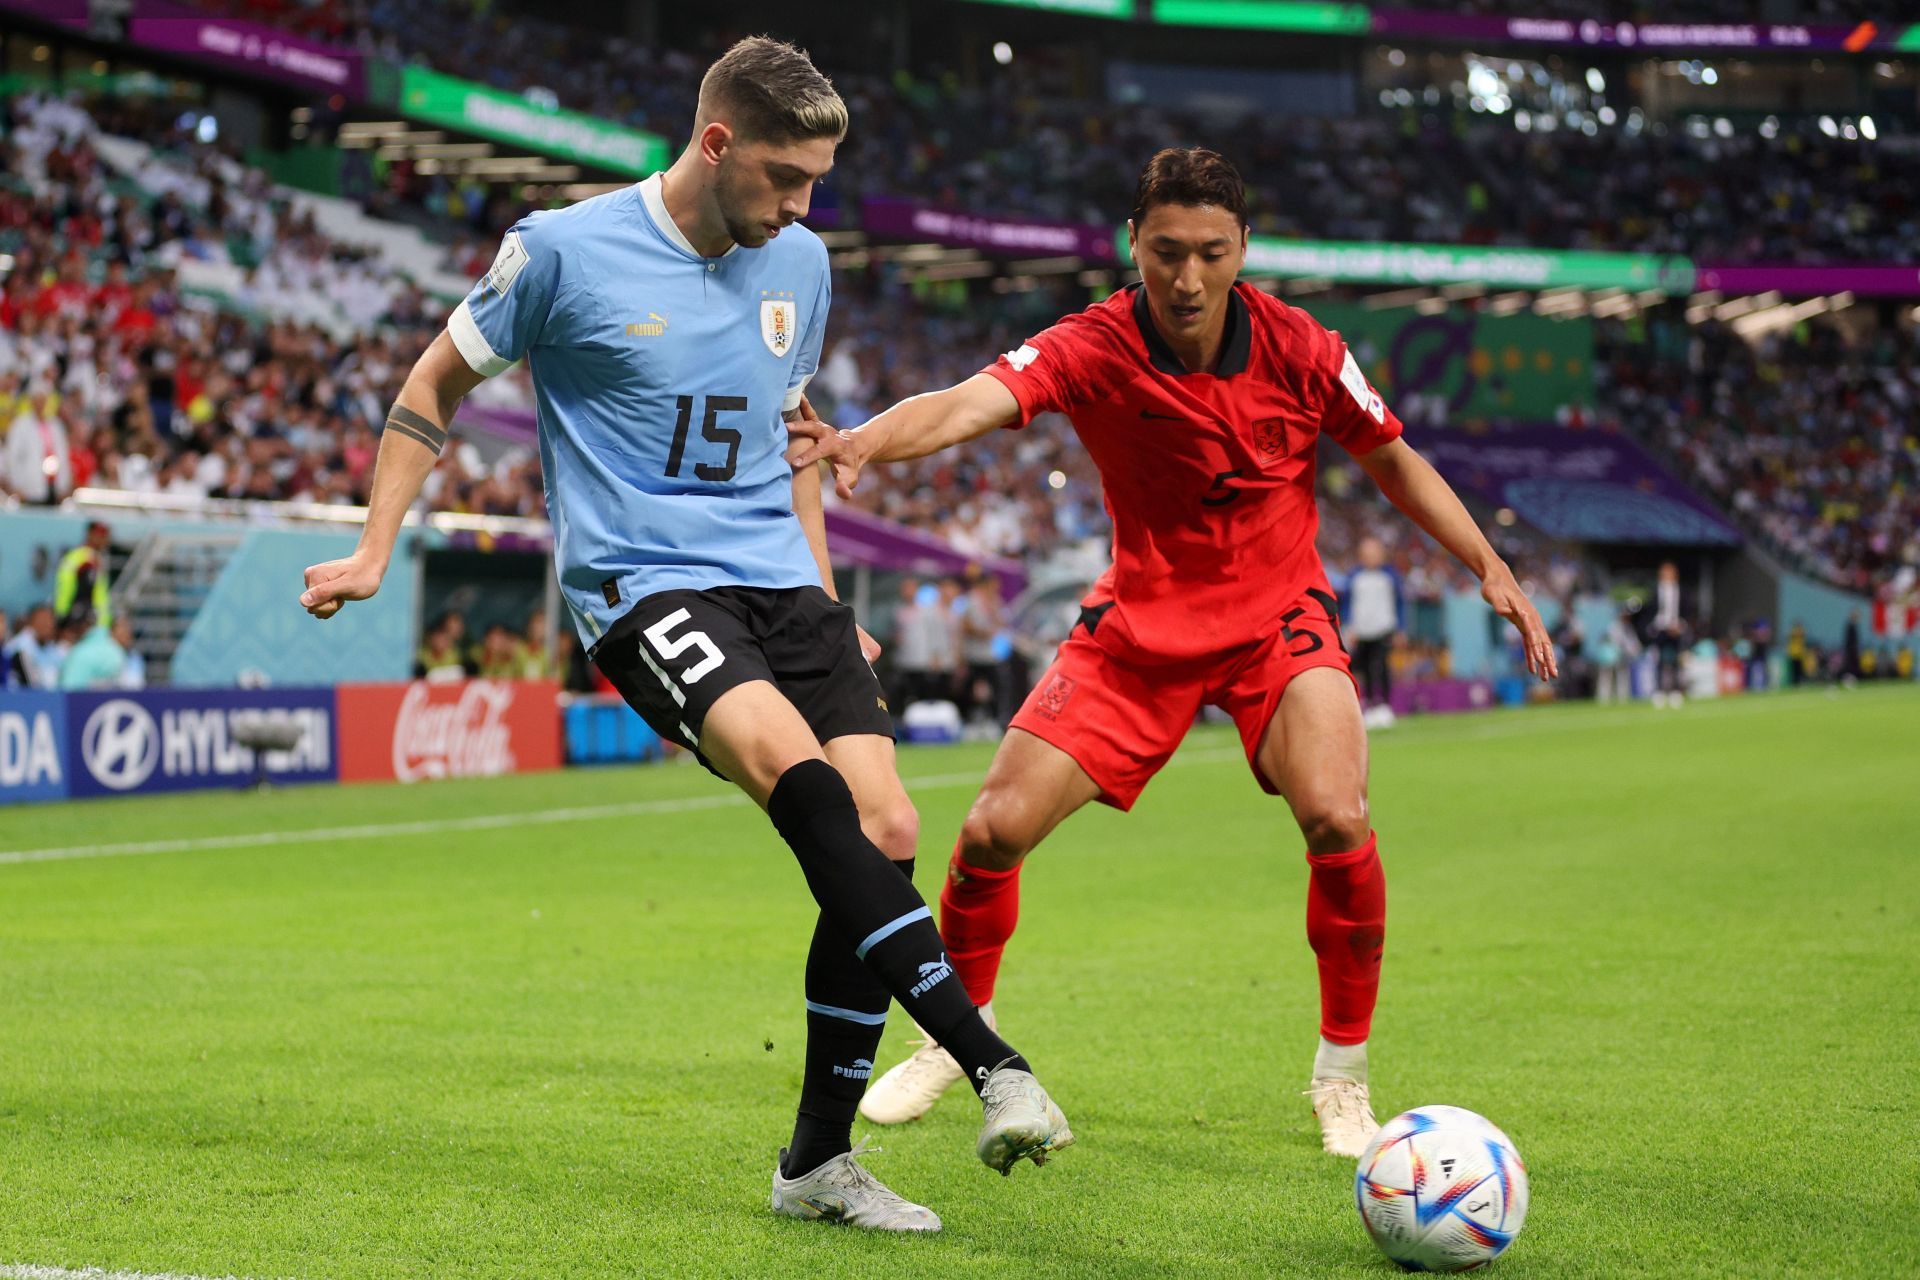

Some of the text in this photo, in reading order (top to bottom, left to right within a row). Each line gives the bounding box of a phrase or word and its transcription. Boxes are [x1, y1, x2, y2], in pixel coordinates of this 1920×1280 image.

[625, 323, 664, 337] PUMA
[775, 310, 784, 330] AUF
[664, 395, 748, 481] 15
[1200, 469, 1243, 507] 5
[1279, 606, 1324, 657] 5
[910, 966, 950, 999] PUMA
